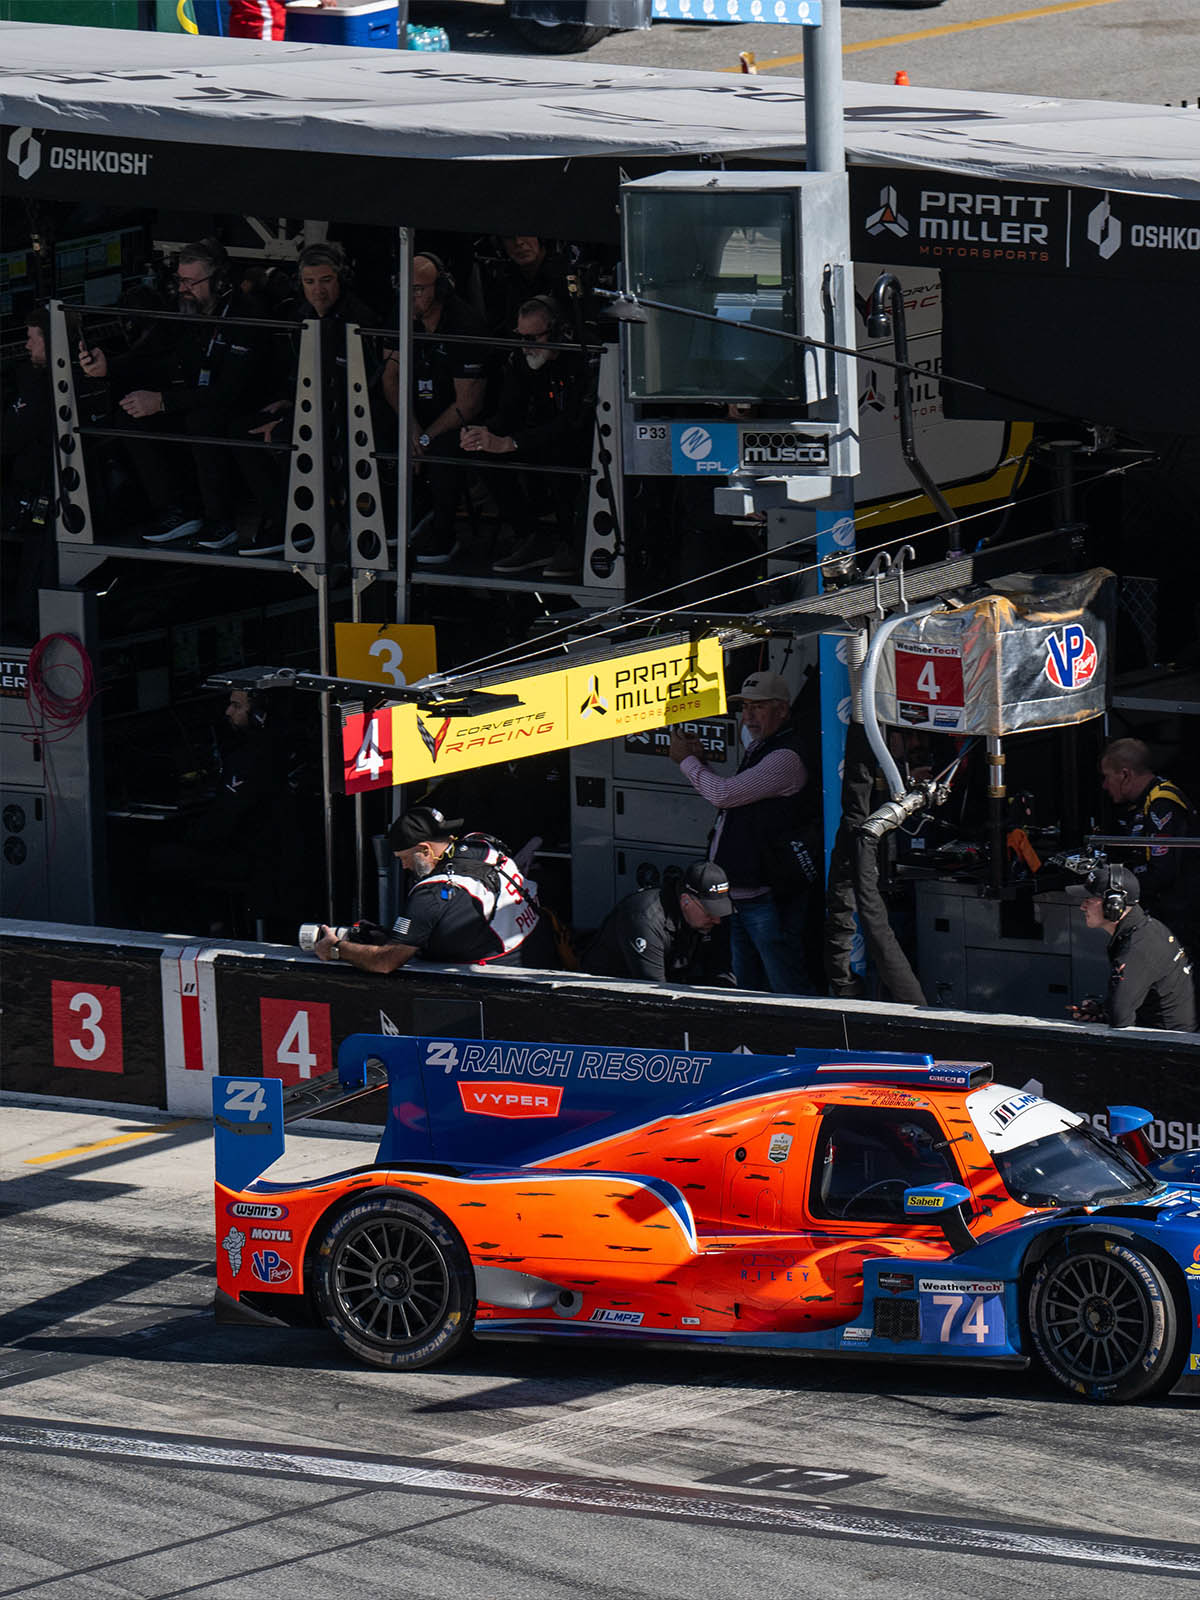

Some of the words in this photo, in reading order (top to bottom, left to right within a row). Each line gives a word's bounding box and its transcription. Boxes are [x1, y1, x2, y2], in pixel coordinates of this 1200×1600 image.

[50, 147, 148, 176] OSHKOSH
[920, 190, 1050, 218] PRATT
[919, 217, 1049, 246] MILLER
[919, 245, 1050, 263] MOTORSPORTS
[696, 461, 729, 473] FPL
[368, 638, 404, 687] 3
[896, 642, 959, 656] WeatherTech
[614, 655, 699, 690] PRATT
[917, 660, 941, 701] 4
[615, 676, 700, 712] MILLER
[455, 711, 548, 738] CORVETTE
[615, 700, 702, 726] MOTORSPORTS
[354, 717, 385, 782] 4
[444, 722, 556, 755] RACING
[68, 991, 107, 1062] 3
[276, 1010, 318, 1079] 4
[460, 1044, 574, 1078] RANCH
[577, 1052, 712, 1085] RESORT
[473, 1092, 550, 1108] VYPER
[909, 1196, 942, 1207] Sabelt
[251, 1228, 292, 1242] MOTUL
[741, 1269, 810, 1282] RILEY
[922, 1282, 1001, 1292] WeatherTech
[604, 1311, 642, 1324] LMP2
[932, 1295, 990, 1344] 74
